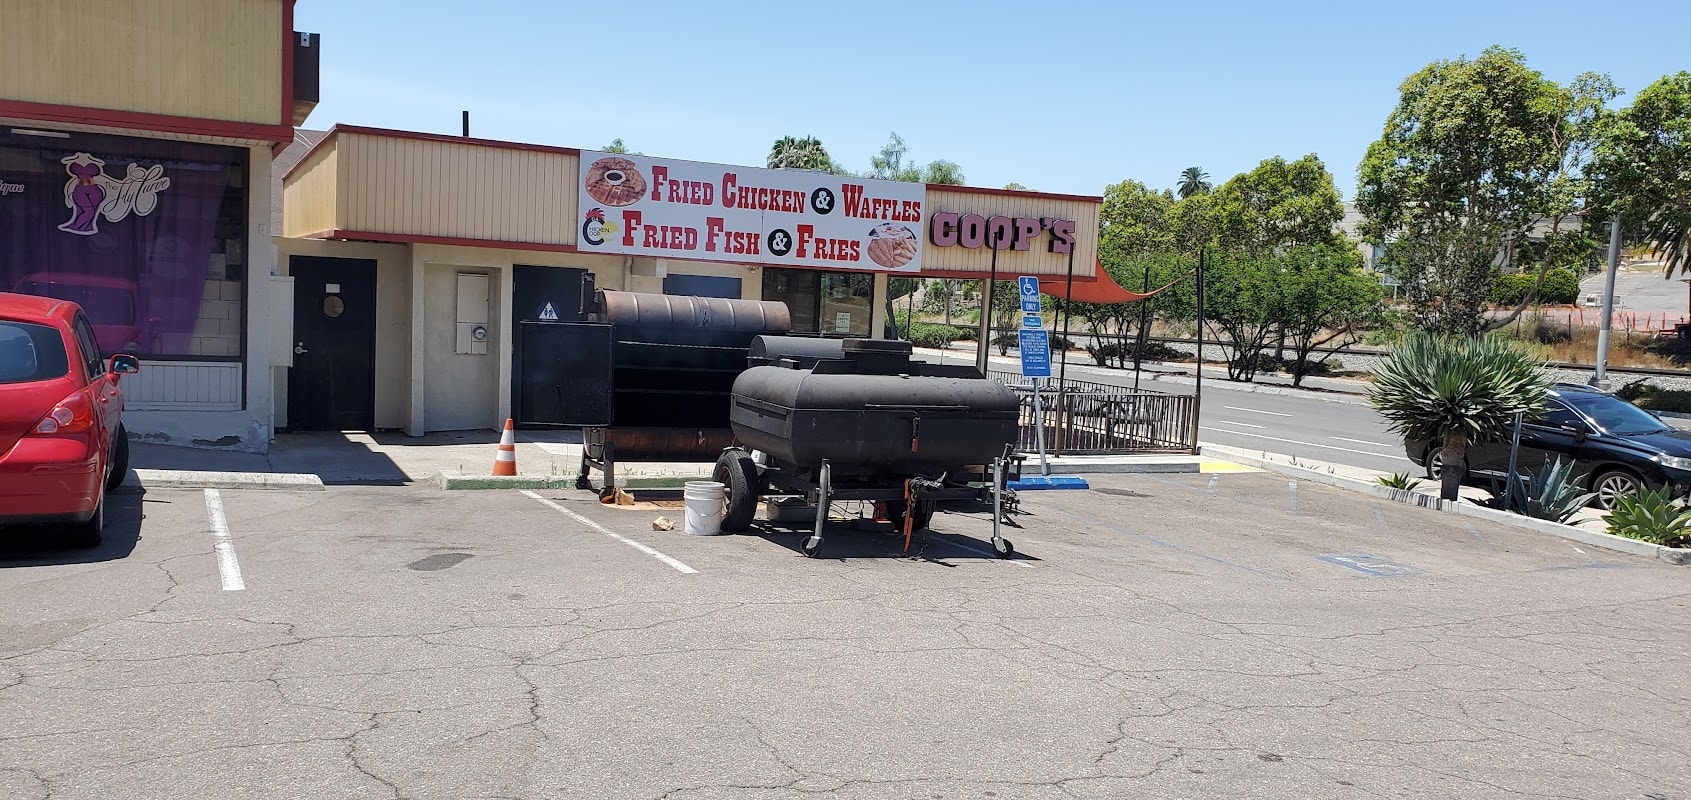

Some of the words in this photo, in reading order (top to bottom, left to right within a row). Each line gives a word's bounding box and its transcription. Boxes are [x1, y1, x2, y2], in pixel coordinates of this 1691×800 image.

[651, 165, 714, 205] FRIED
[721, 172, 806, 214] CHICKEN
[814, 189, 832, 211] &
[841, 183, 921, 223] WAFFLES
[622, 210, 698, 250] FRIED
[704, 216, 760, 255] FISH
[771, 231, 789, 253] &
[795, 224, 861, 262] FRIES
[929, 211, 1076, 254] COOP'S
[1021, 294, 1039, 303] PARKING
